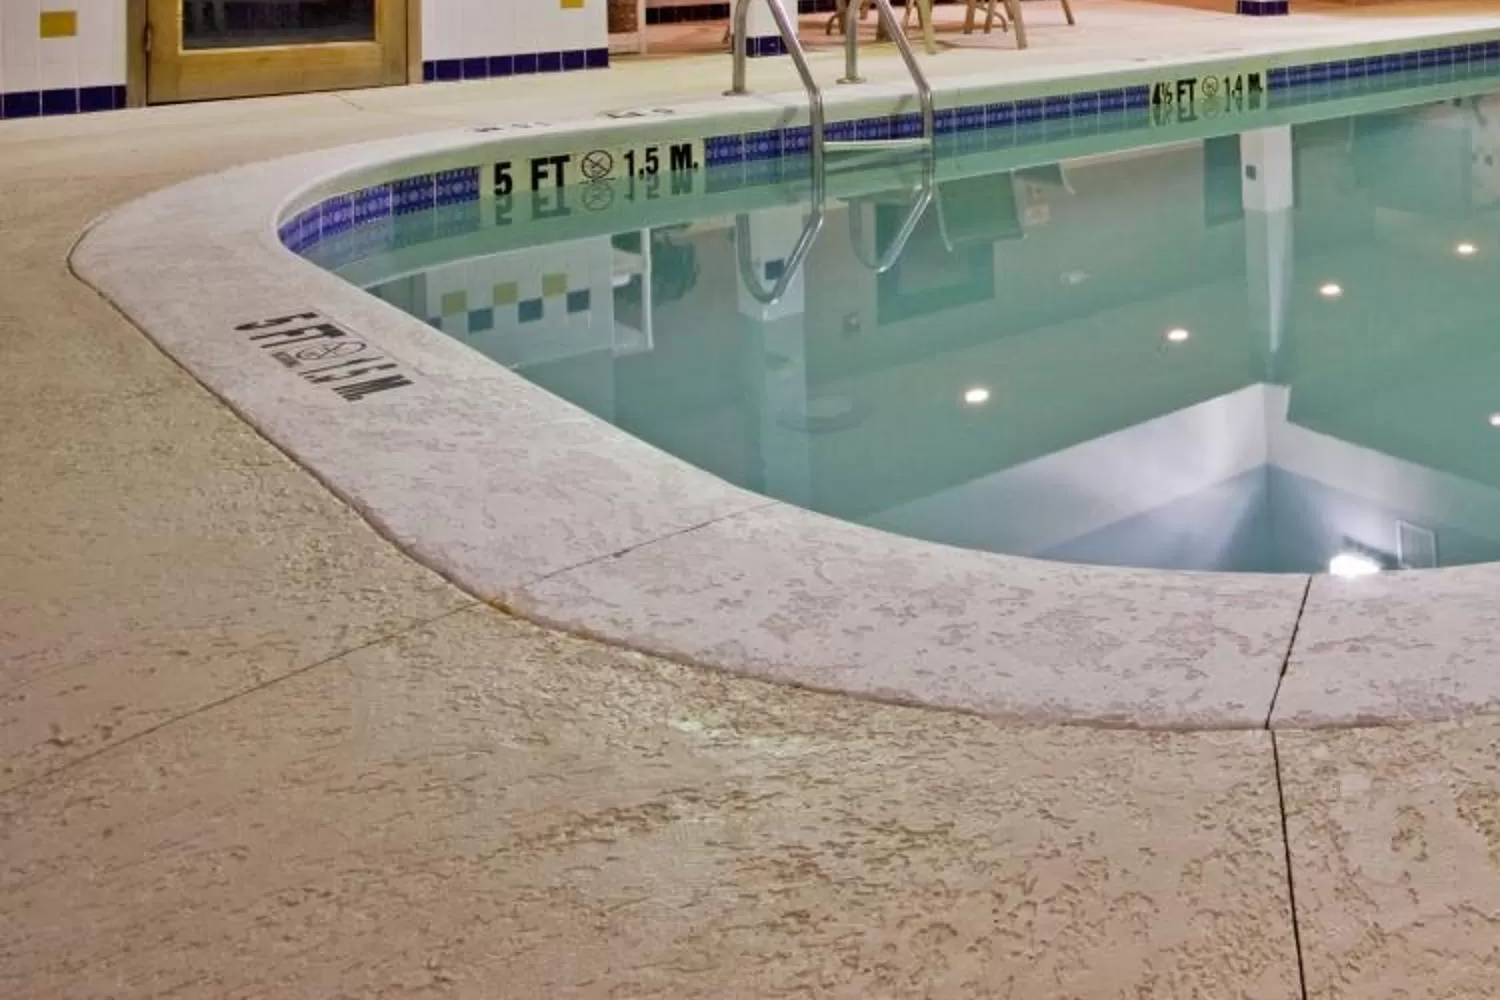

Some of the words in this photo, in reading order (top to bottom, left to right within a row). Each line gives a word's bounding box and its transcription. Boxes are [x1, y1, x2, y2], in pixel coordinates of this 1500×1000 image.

[1176, 77, 1197, 103] FT
[493, 161, 514, 196] 5
[529, 154, 572, 192] FT
[623, 147, 660, 180] 1.5
[669, 143, 699, 172] M.
